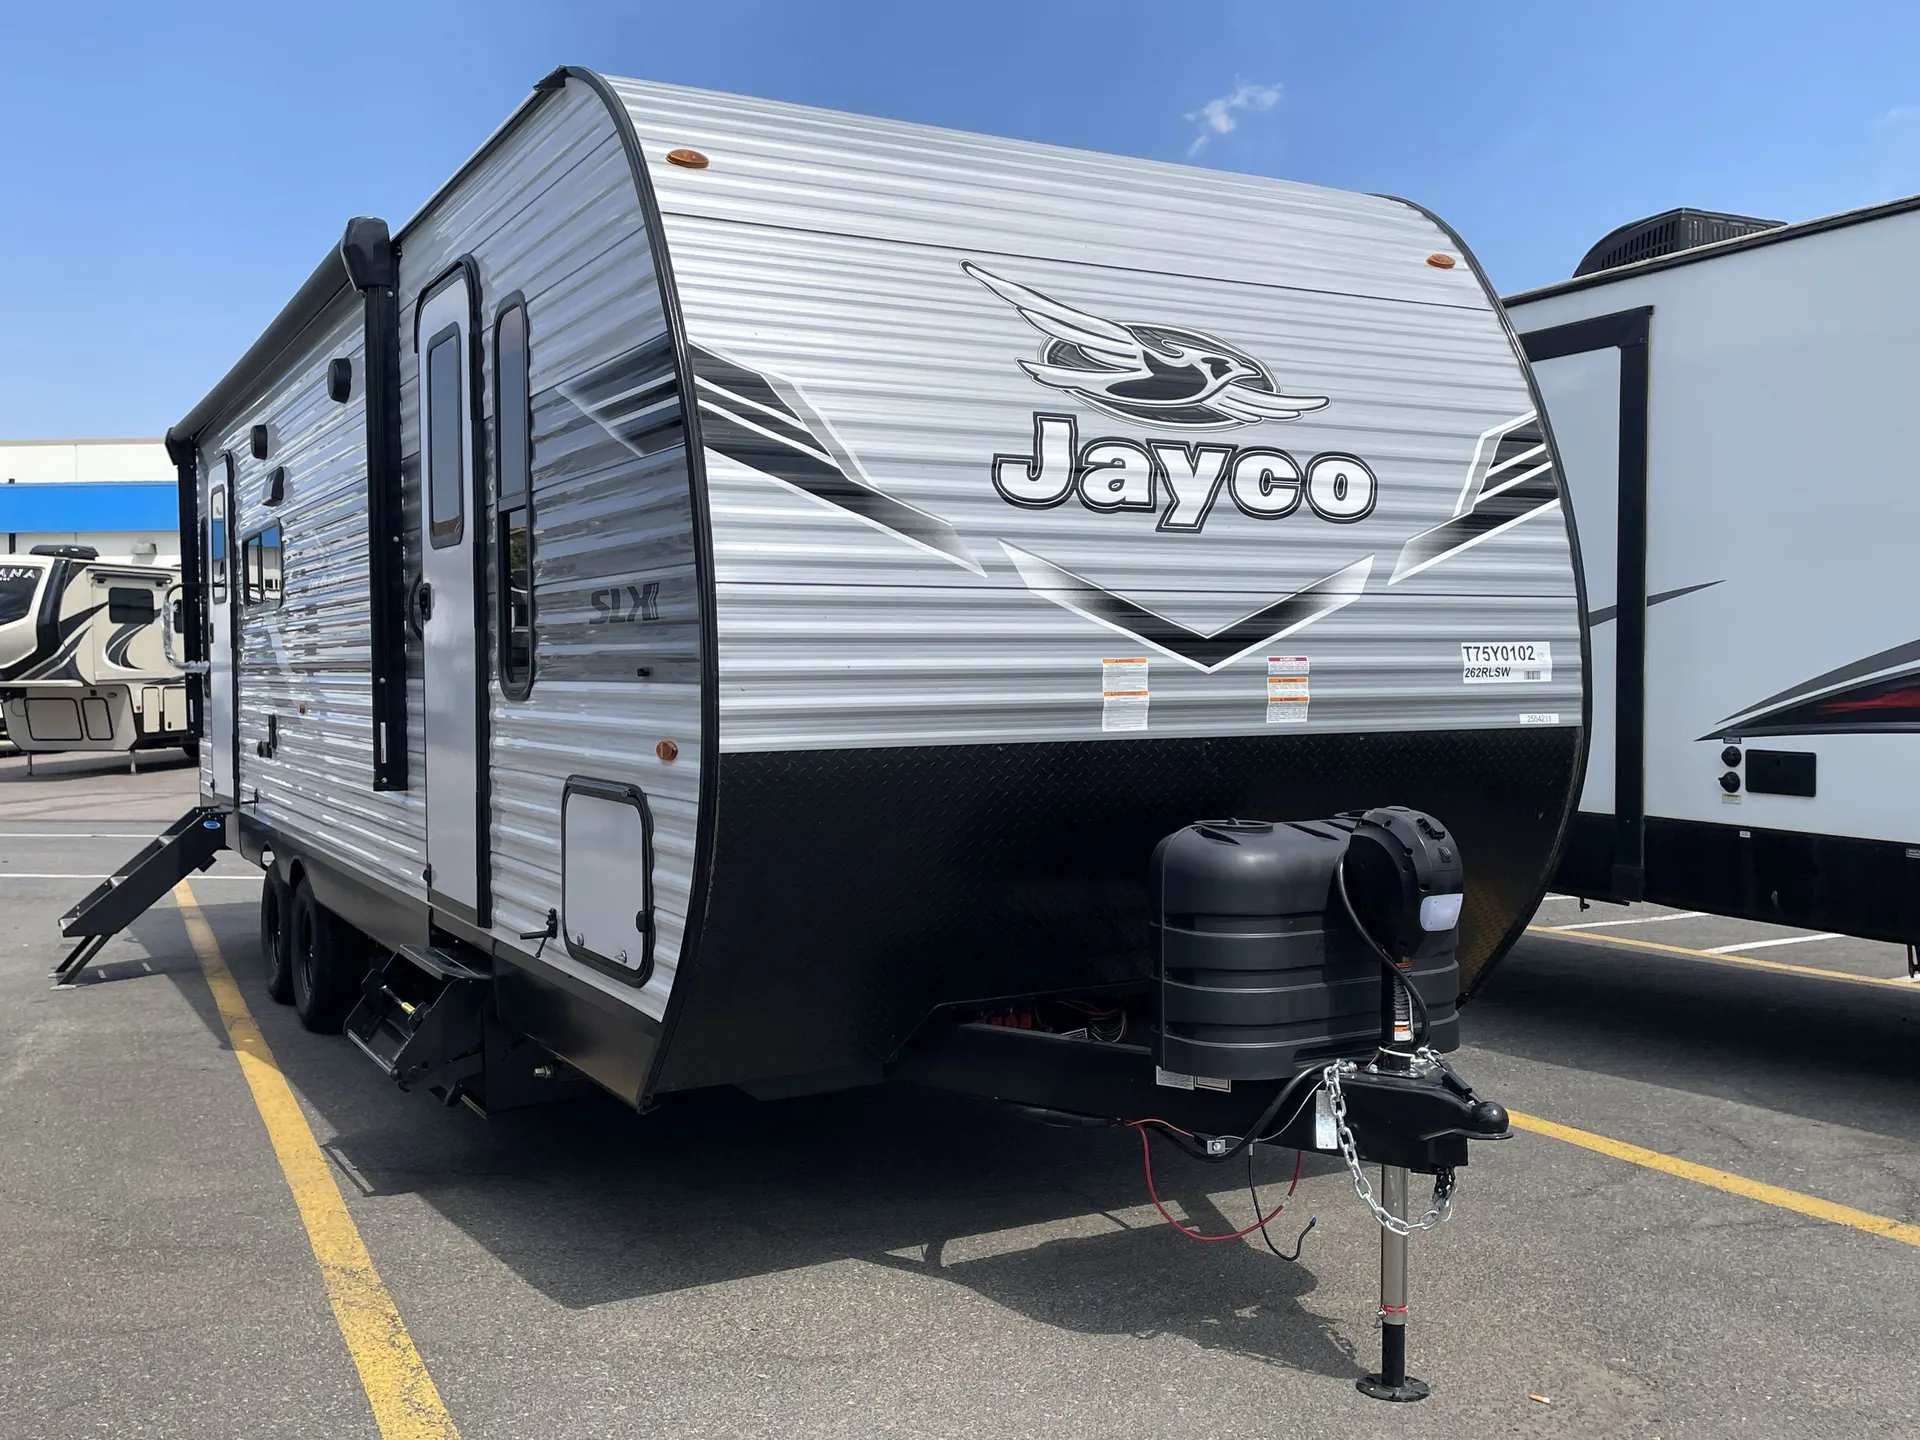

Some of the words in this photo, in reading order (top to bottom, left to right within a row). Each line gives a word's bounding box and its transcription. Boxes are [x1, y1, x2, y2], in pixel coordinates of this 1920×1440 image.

[991, 411, 1378, 533] Jayco
[589, 582, 660, 625] SLX
[1463, 645, 1536, 662] T75Y0102
[1464, 667, 1511, 678] 262RLSW
